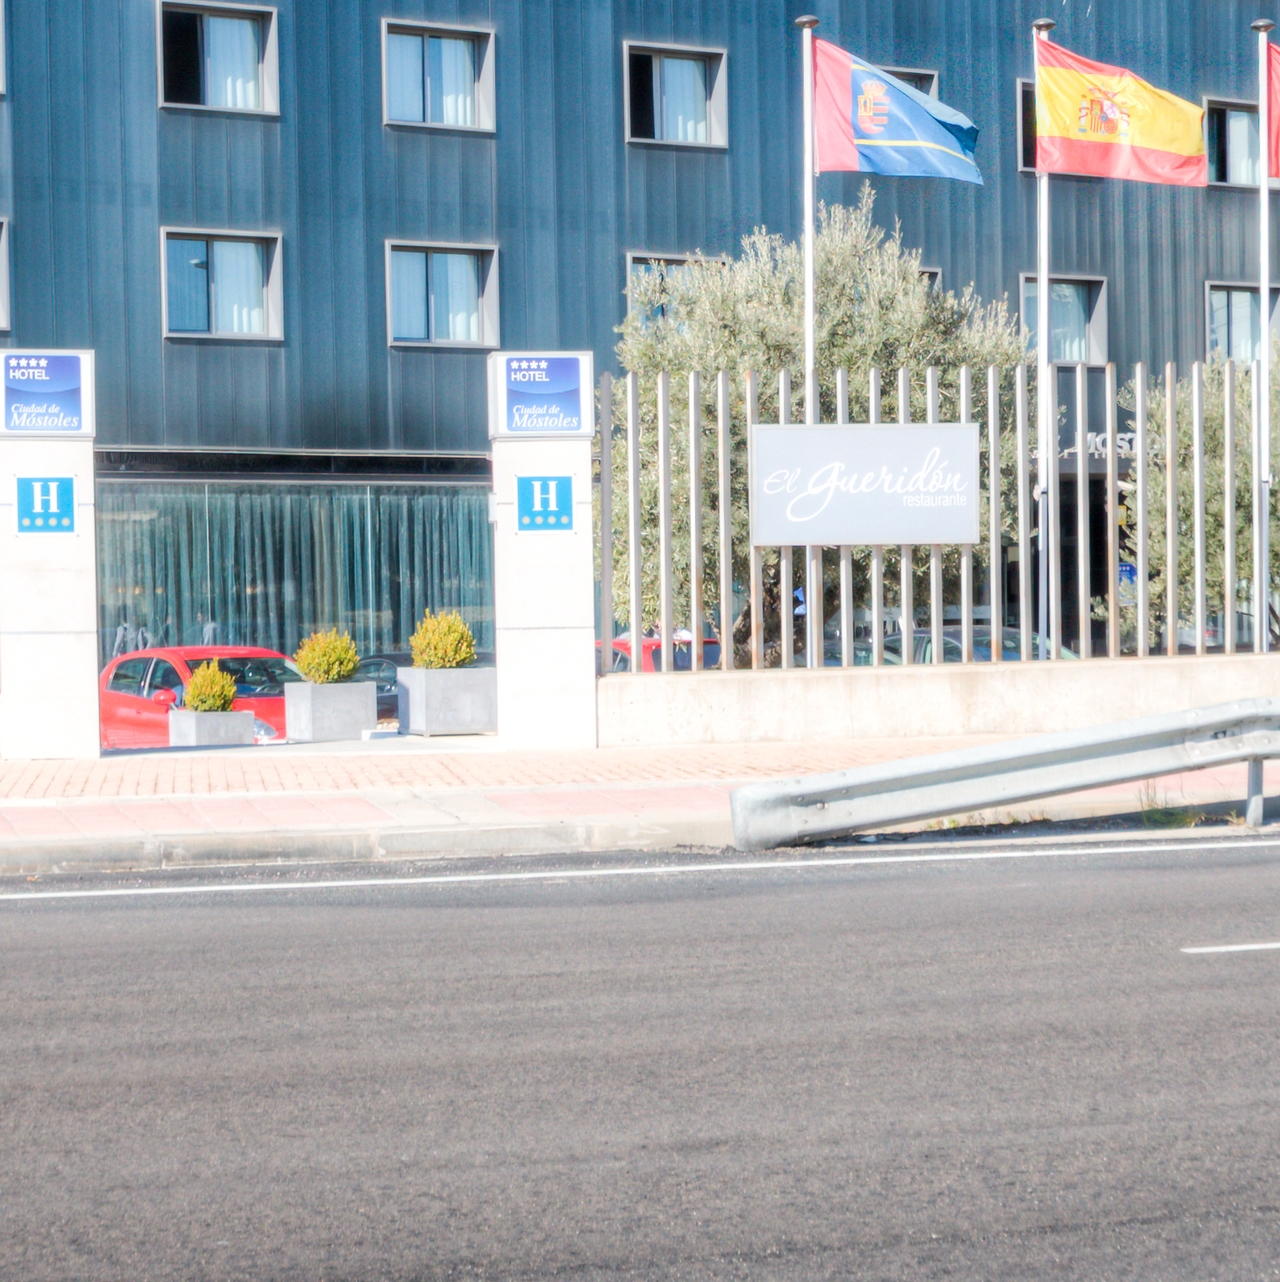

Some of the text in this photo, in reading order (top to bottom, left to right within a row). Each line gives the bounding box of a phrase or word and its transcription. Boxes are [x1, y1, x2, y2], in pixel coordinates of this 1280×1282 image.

[9, 369, 50, 380] HOTEL
[510, 371, 550, 382] HOTEL
[11, 403, 61, 414] Ciudad de
[512, 405, 560, 415] Ciudad de
[10, 411, 80, 427] Móstoles
[511, 413, 579, 428] Móstoles
[763, 468, 801, 495] El
[31, 481, 60, 513] H
[531, 480, 559, 512] H
[902, 493, 967, 507] restaurante
